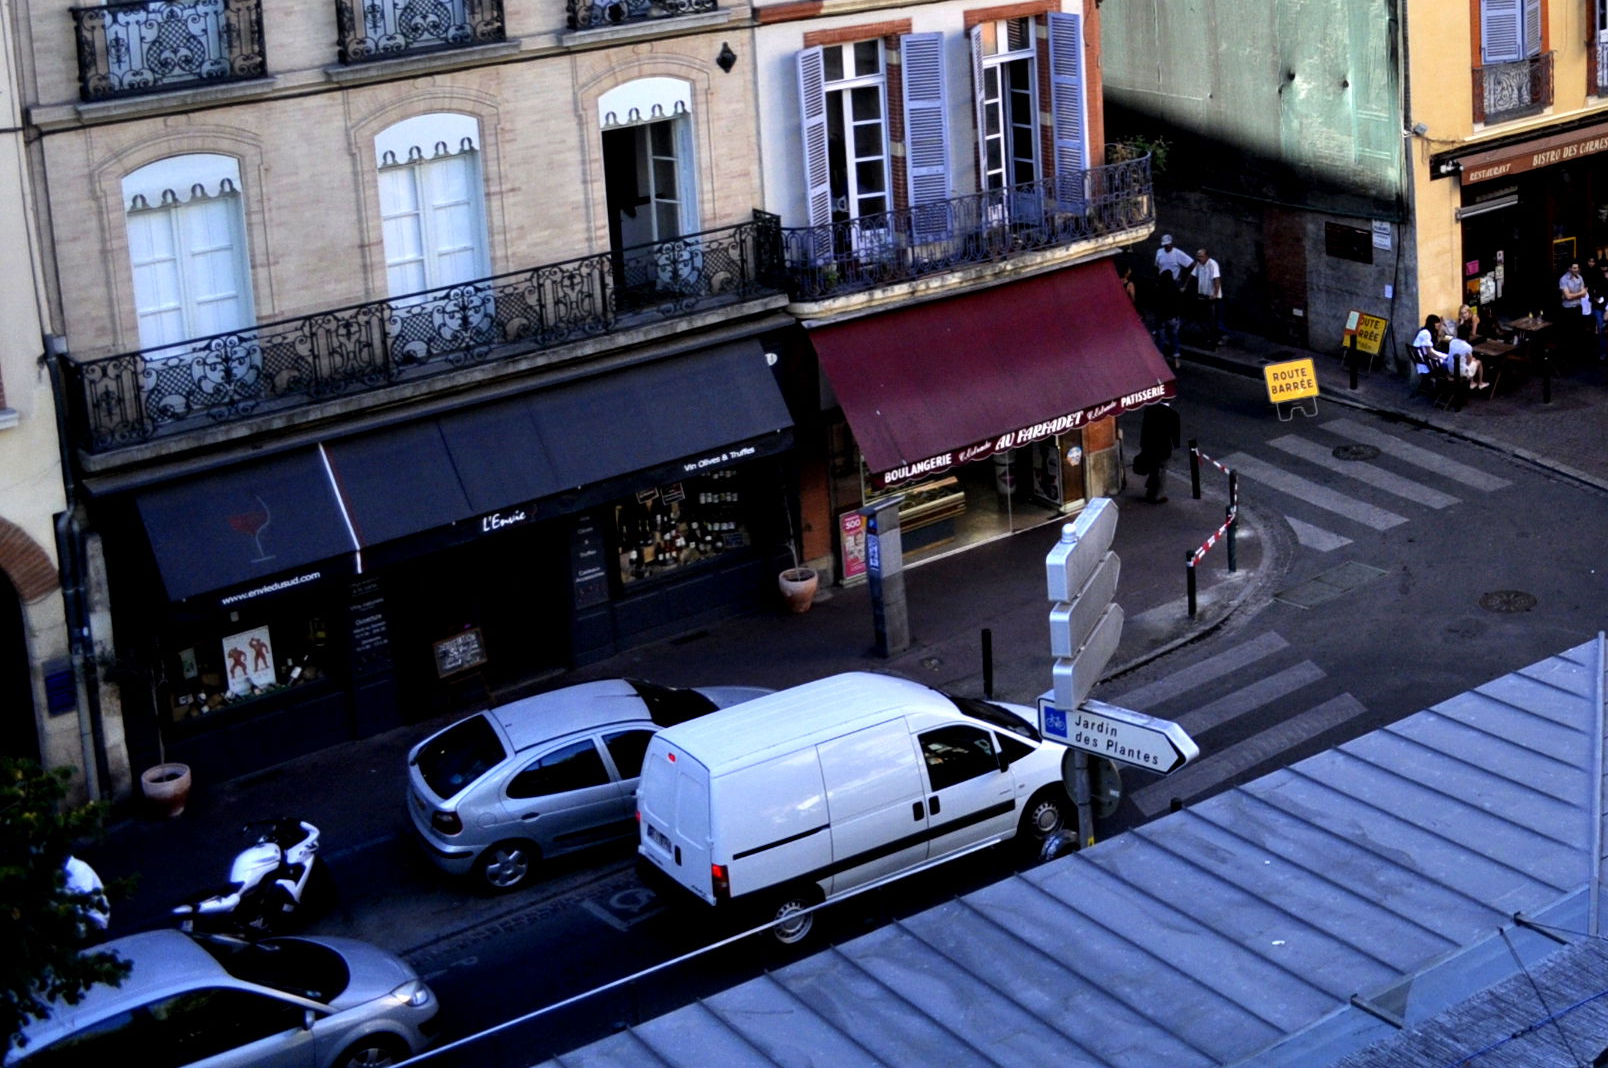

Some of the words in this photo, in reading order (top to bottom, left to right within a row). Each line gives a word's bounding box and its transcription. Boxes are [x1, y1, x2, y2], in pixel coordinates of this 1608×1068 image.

[1532, 149, 1560, 167] BISTRO
[1563, 143, 1577, 159] DES
[1579, 136, 1608, 155] CARMES
[1469, 163, 1512, 182] RESTAURANT
[1271, 378, 1314, 395] BARRÉE
[1272, 367, 1308, 382] ROUTE
[1120, 385, 1166, 408] PATISSERIE
[995, 432, 1016, 451] AU
[1016, 410, 1084, 444] FARFADET
[683, 463, 697, 472] Vin
[697, 457, 721, 468] Olives
[721, 453, 729, 462] &
[729, 446, 755, 459] Truffes
[884, 452, 952, 484] BOULANGERIE
[482, 509, 527, 532] L'Envie
[221, 571, 321, 605] www.enviedusud.com
[1075, 715, 1118, 737] Jardin
[1075, 731, 1098, 747] des
[1106, 739, 1159, 765] Plantes
